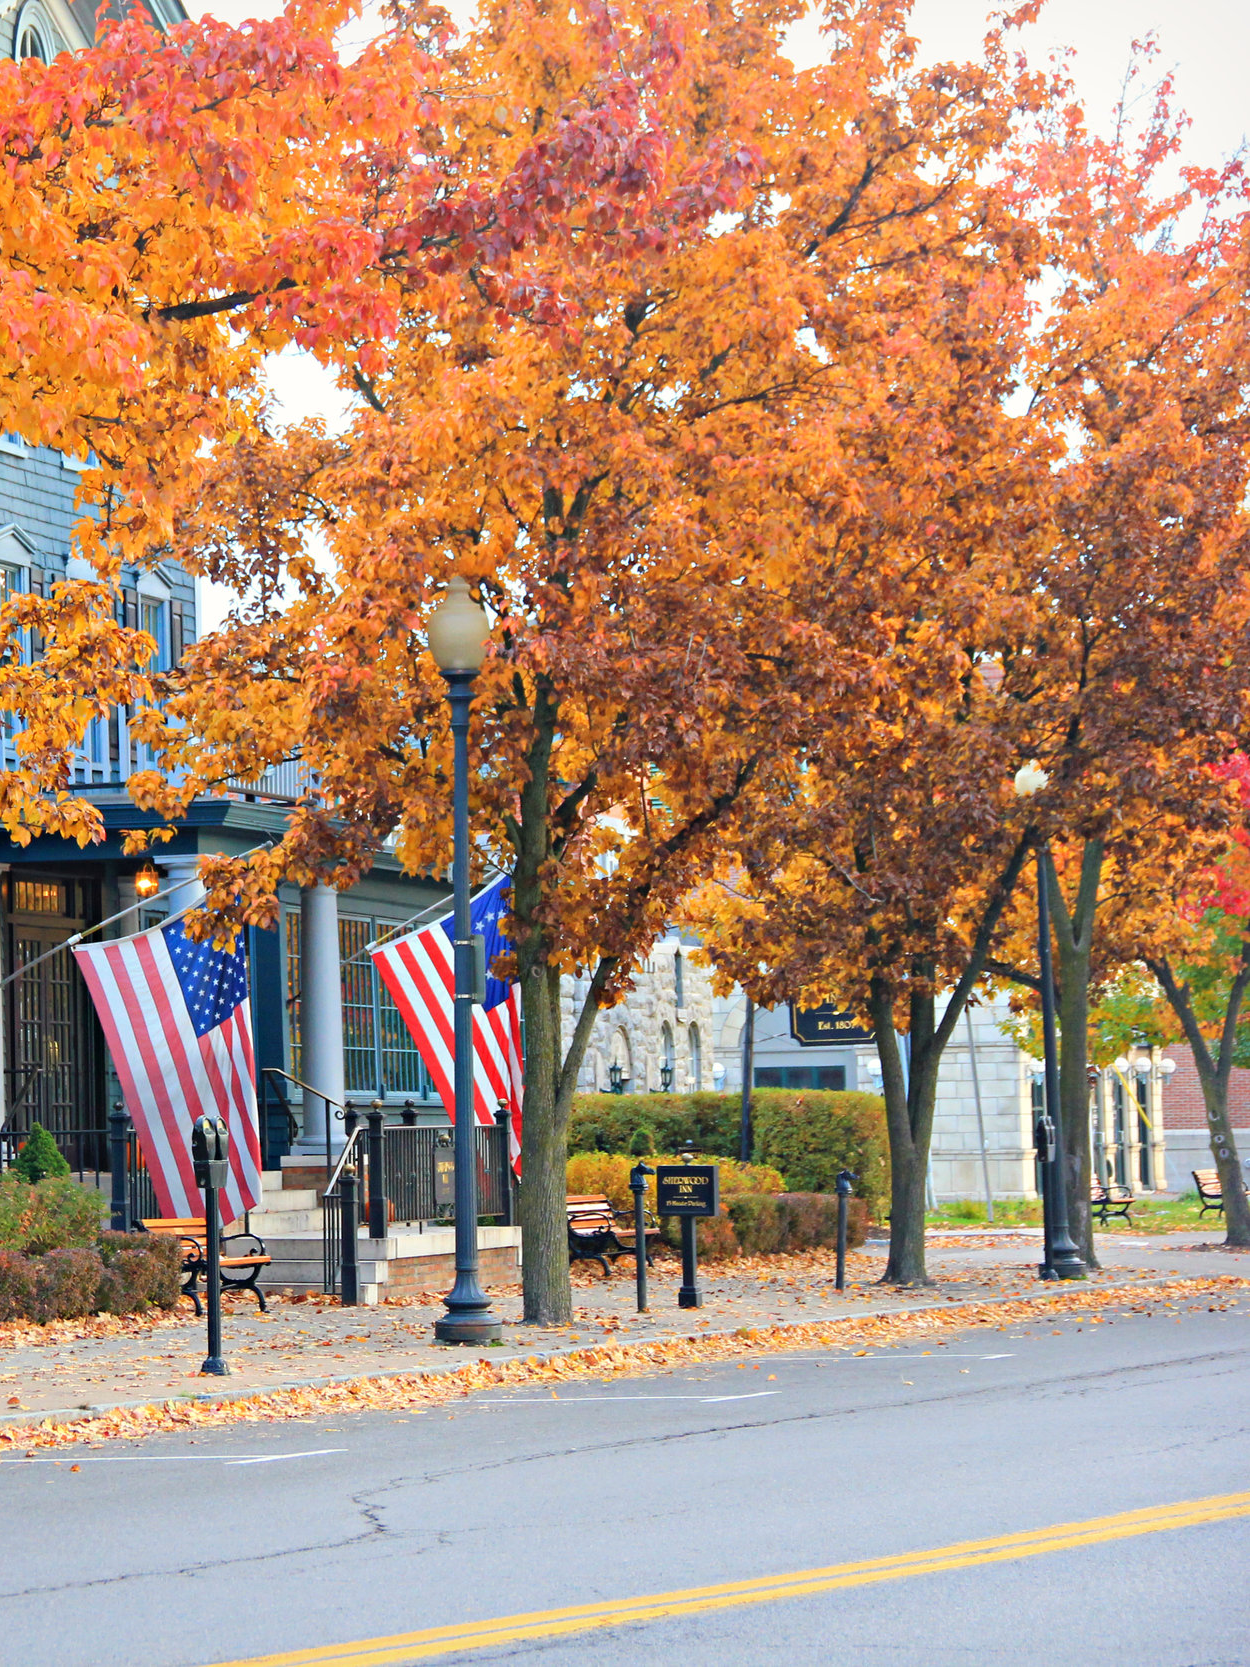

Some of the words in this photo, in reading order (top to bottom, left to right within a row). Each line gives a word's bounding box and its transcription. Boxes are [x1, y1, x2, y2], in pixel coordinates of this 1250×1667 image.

[818, 1021, 833, 1030] Est.
[662, 1176, 709, 1185] SHERWOOD
[679, 1184, 693, 1193] INN
